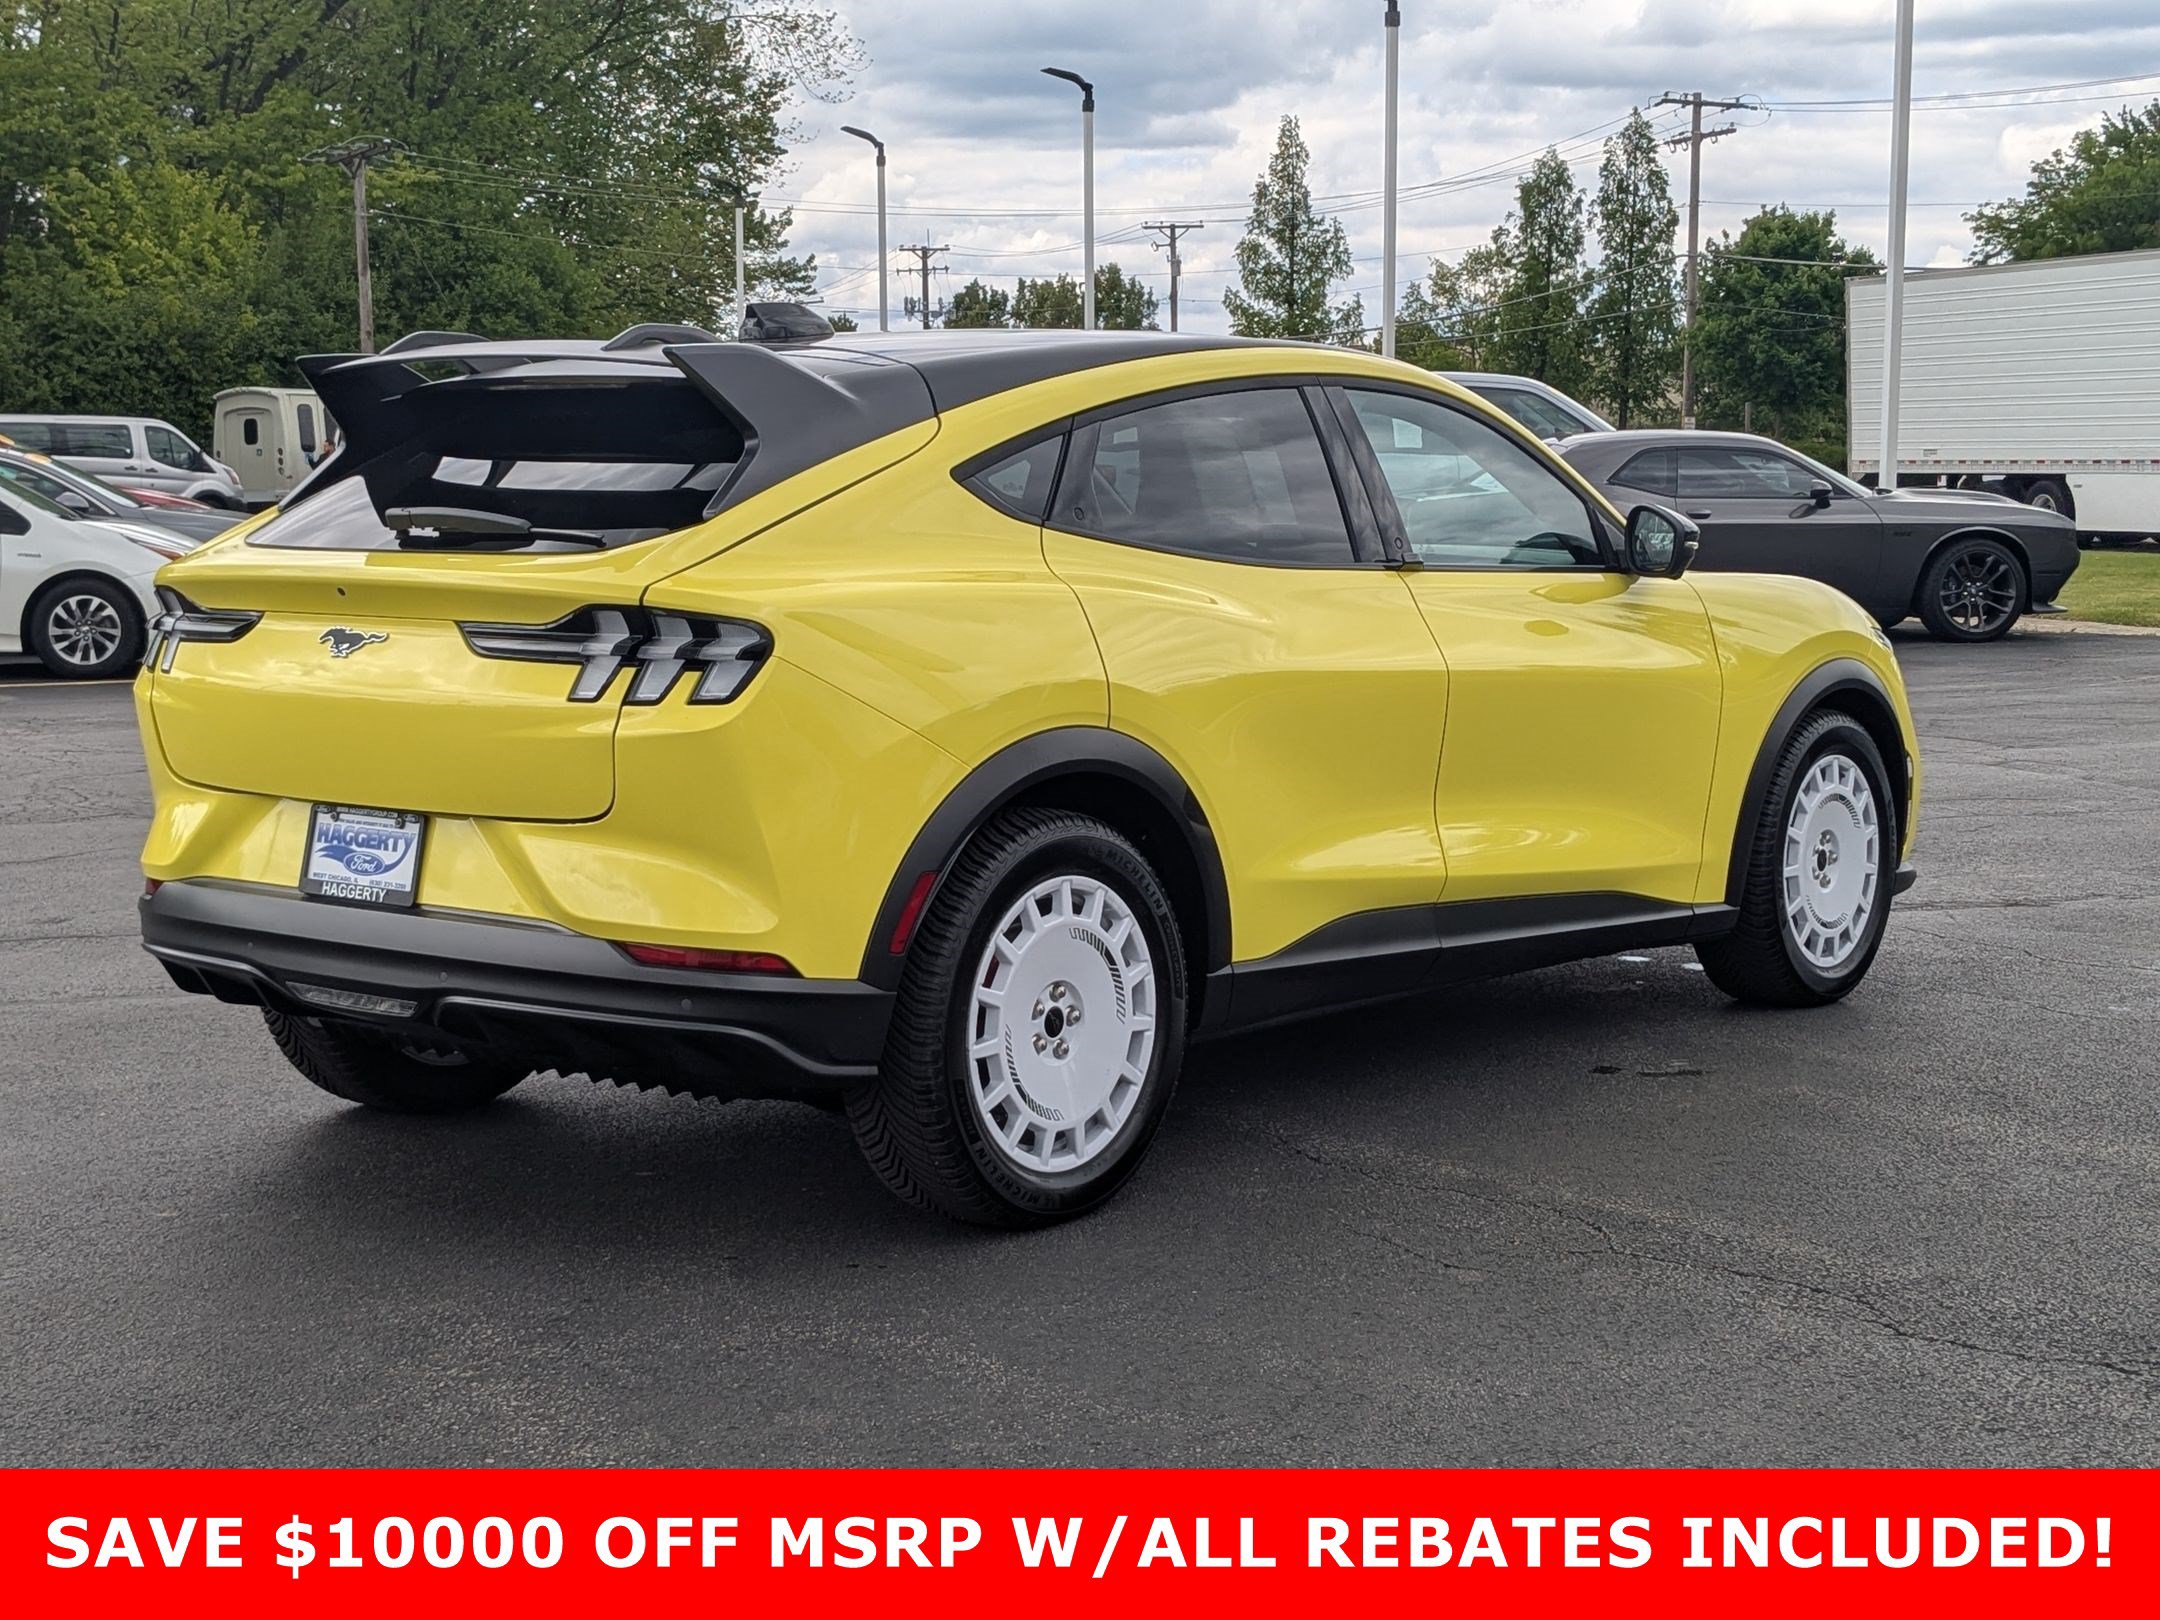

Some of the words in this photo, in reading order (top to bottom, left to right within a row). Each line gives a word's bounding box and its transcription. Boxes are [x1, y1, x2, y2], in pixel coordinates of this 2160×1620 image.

[317, 822, 416, 852] HAGGERTY
[350, 855, 377, 873] Ford
[1105, 847, 1164, 911] MICHELIN
[321, 881, 387, 903] HAGGERTY
[975, 1146, 1041, 1205] MICHELIN
